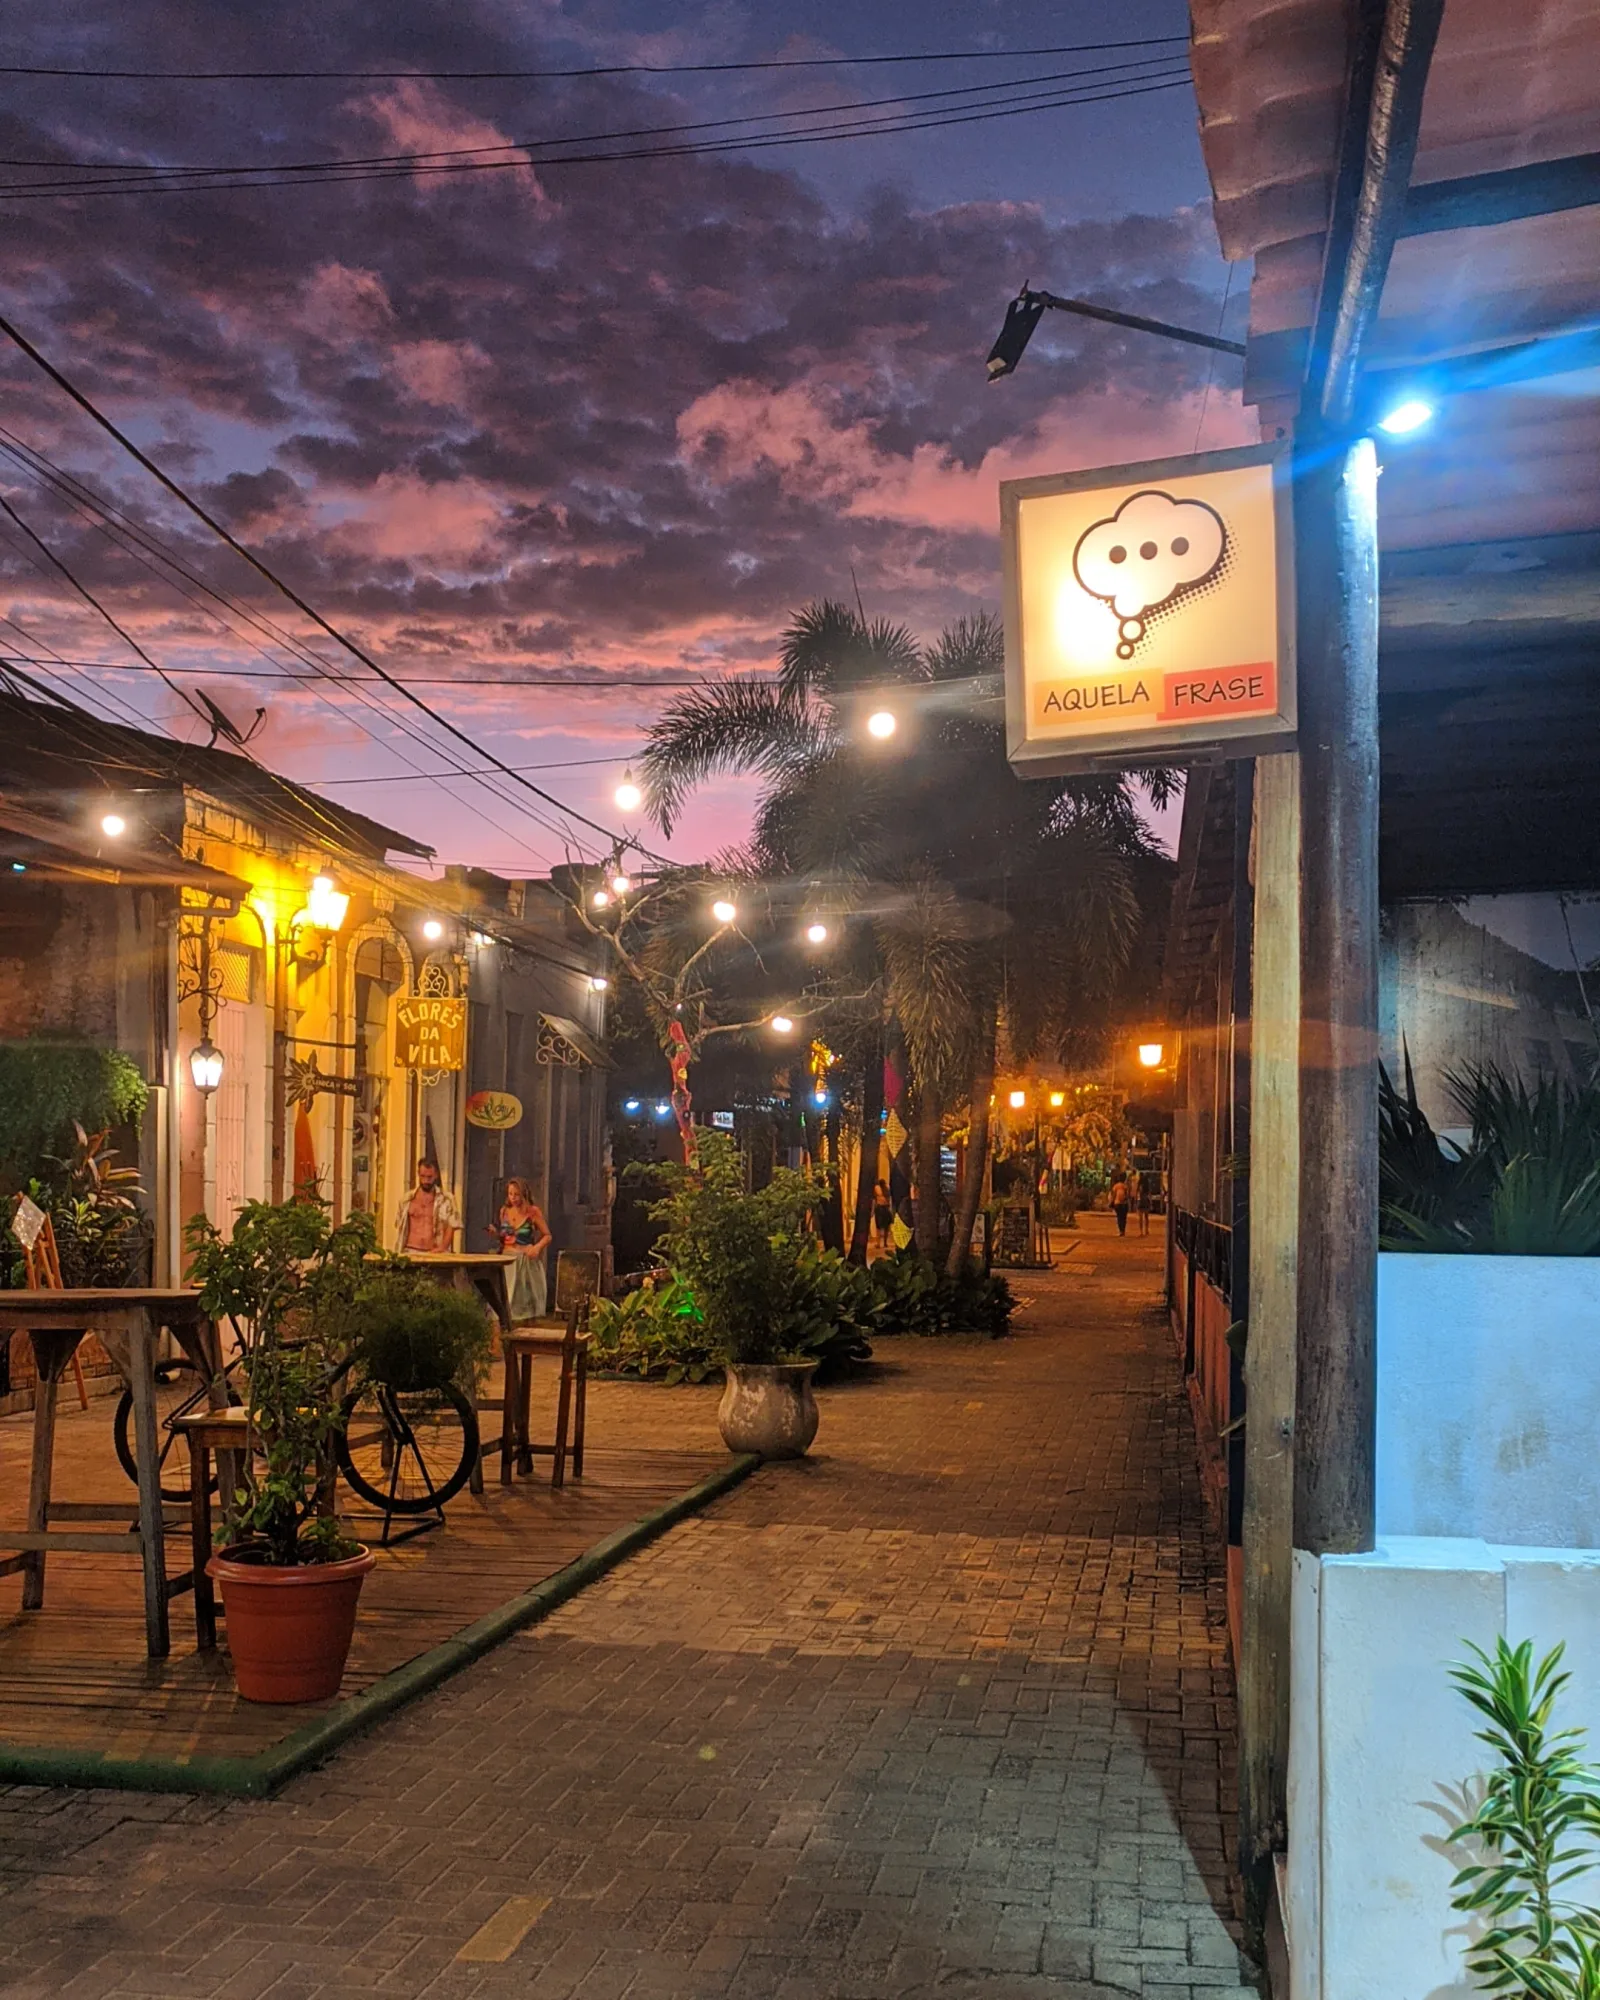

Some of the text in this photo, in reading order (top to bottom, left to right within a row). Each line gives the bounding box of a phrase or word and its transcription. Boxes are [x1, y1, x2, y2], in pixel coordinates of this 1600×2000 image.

[1043, 675, 1265, 713] AQUELA FRASE
[397, 1002, 463, 1029] FLORES
[420, 1026, 440, 1041] DA
[343, 1082, 358, 1092] SOL
